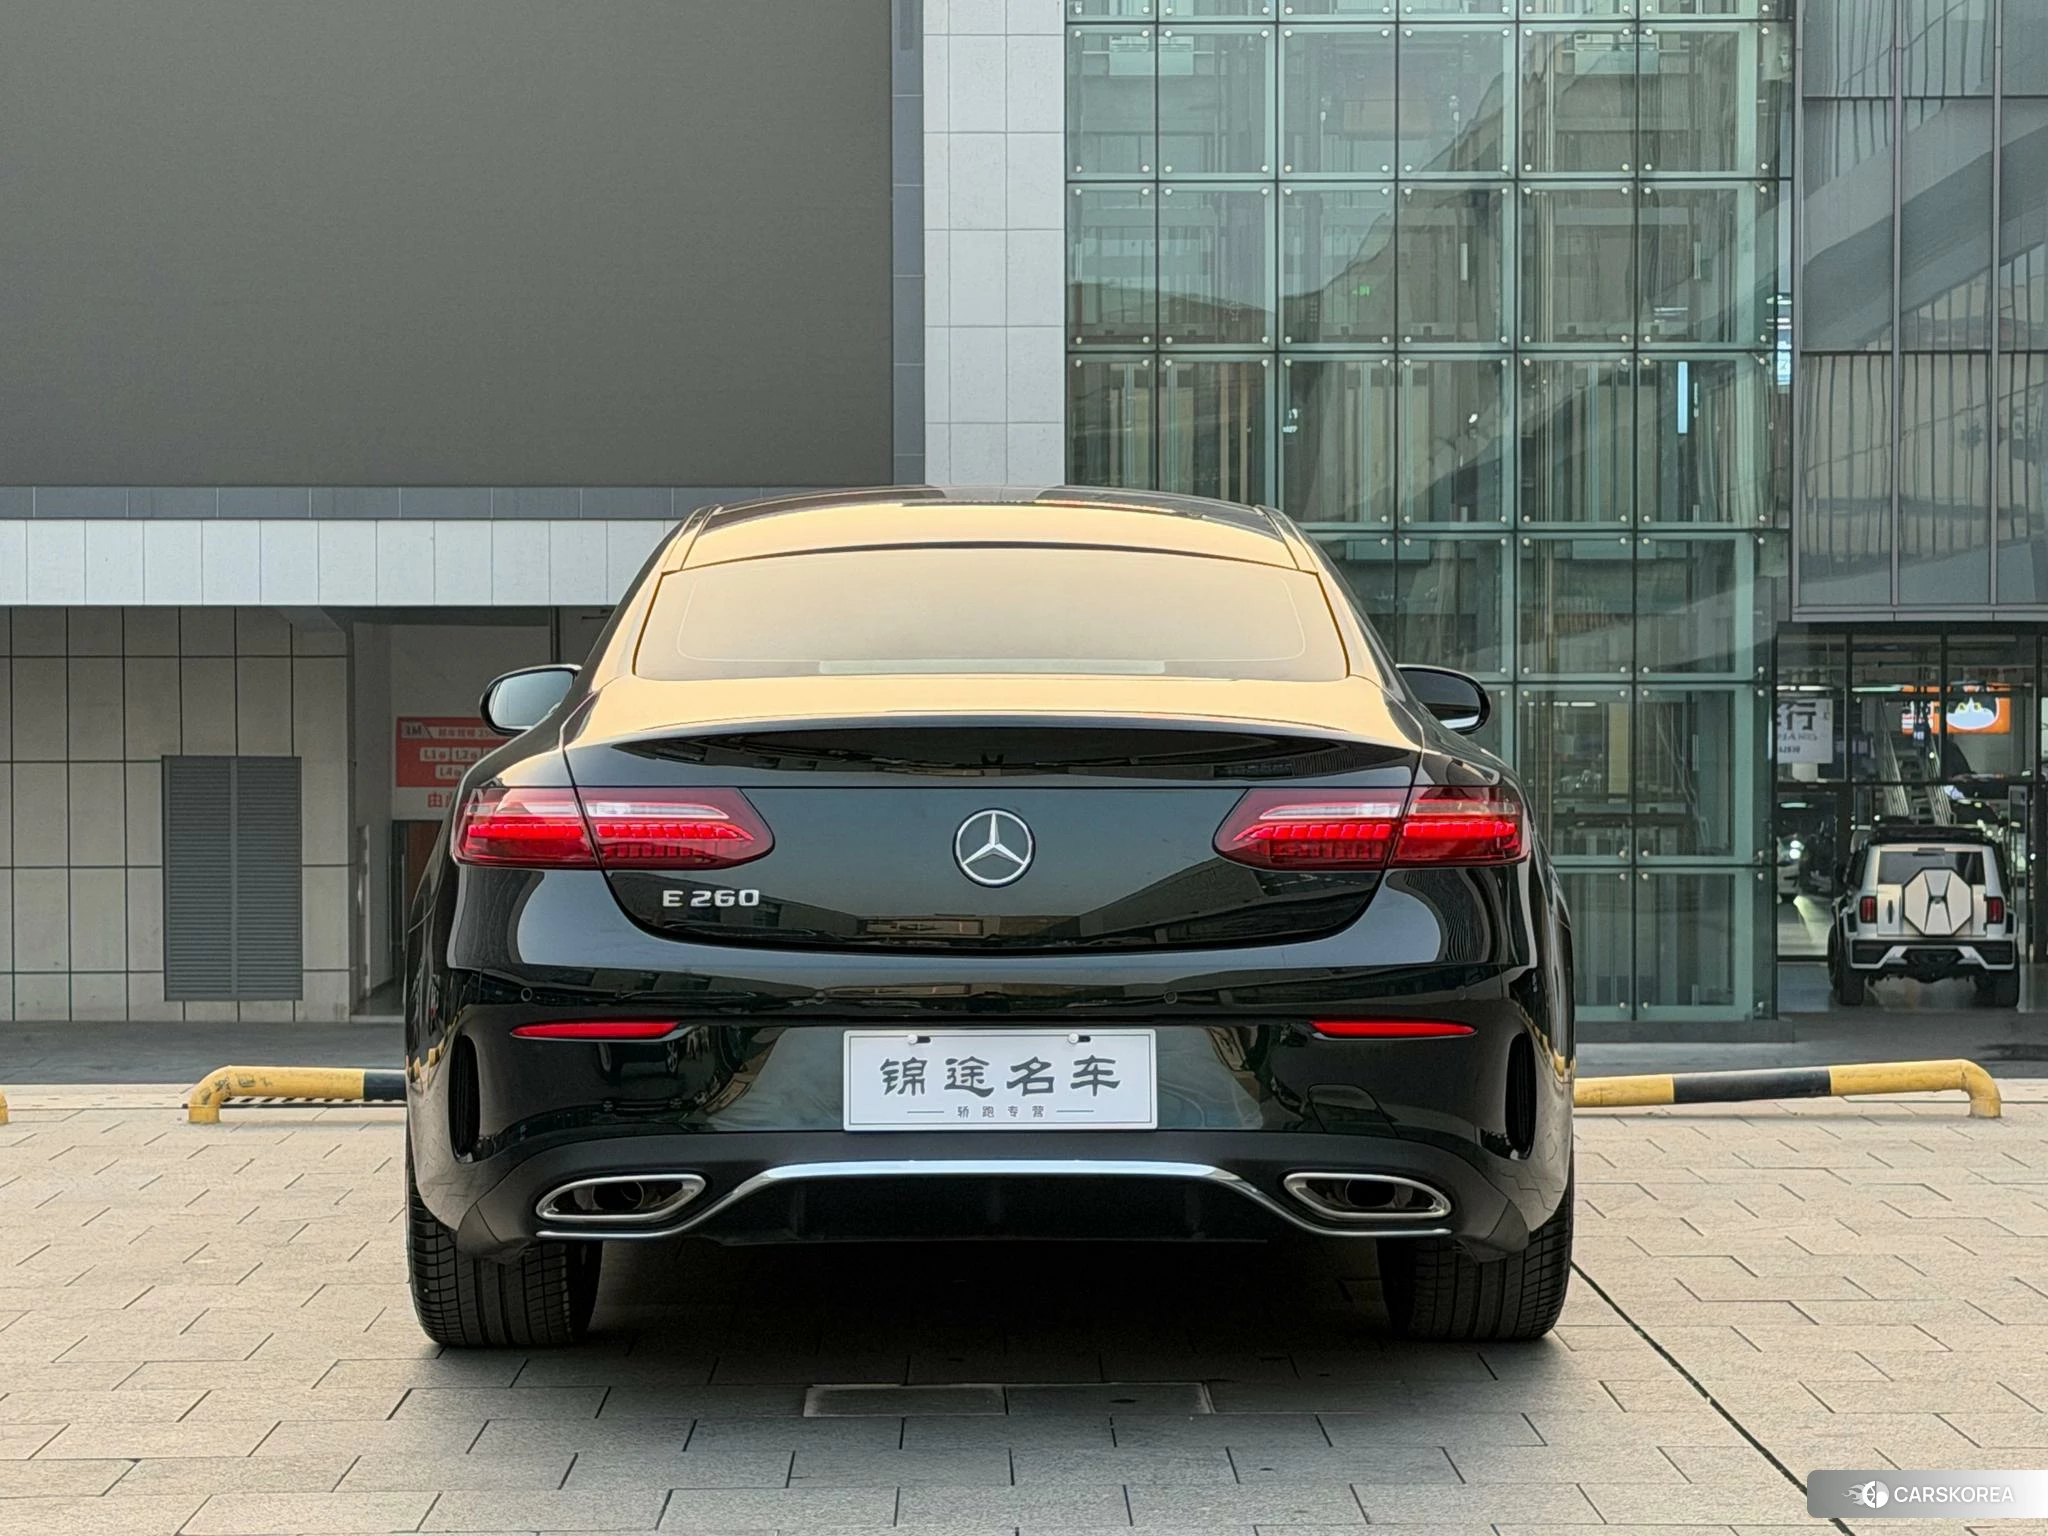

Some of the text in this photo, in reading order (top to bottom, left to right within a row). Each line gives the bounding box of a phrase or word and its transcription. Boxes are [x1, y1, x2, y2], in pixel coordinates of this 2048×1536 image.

[662, 889, 760, 908] E 260
[880, 1054, 1121, 1098] 锦途名车
[957, 1105, 1045, 1119] 轿跑专营
